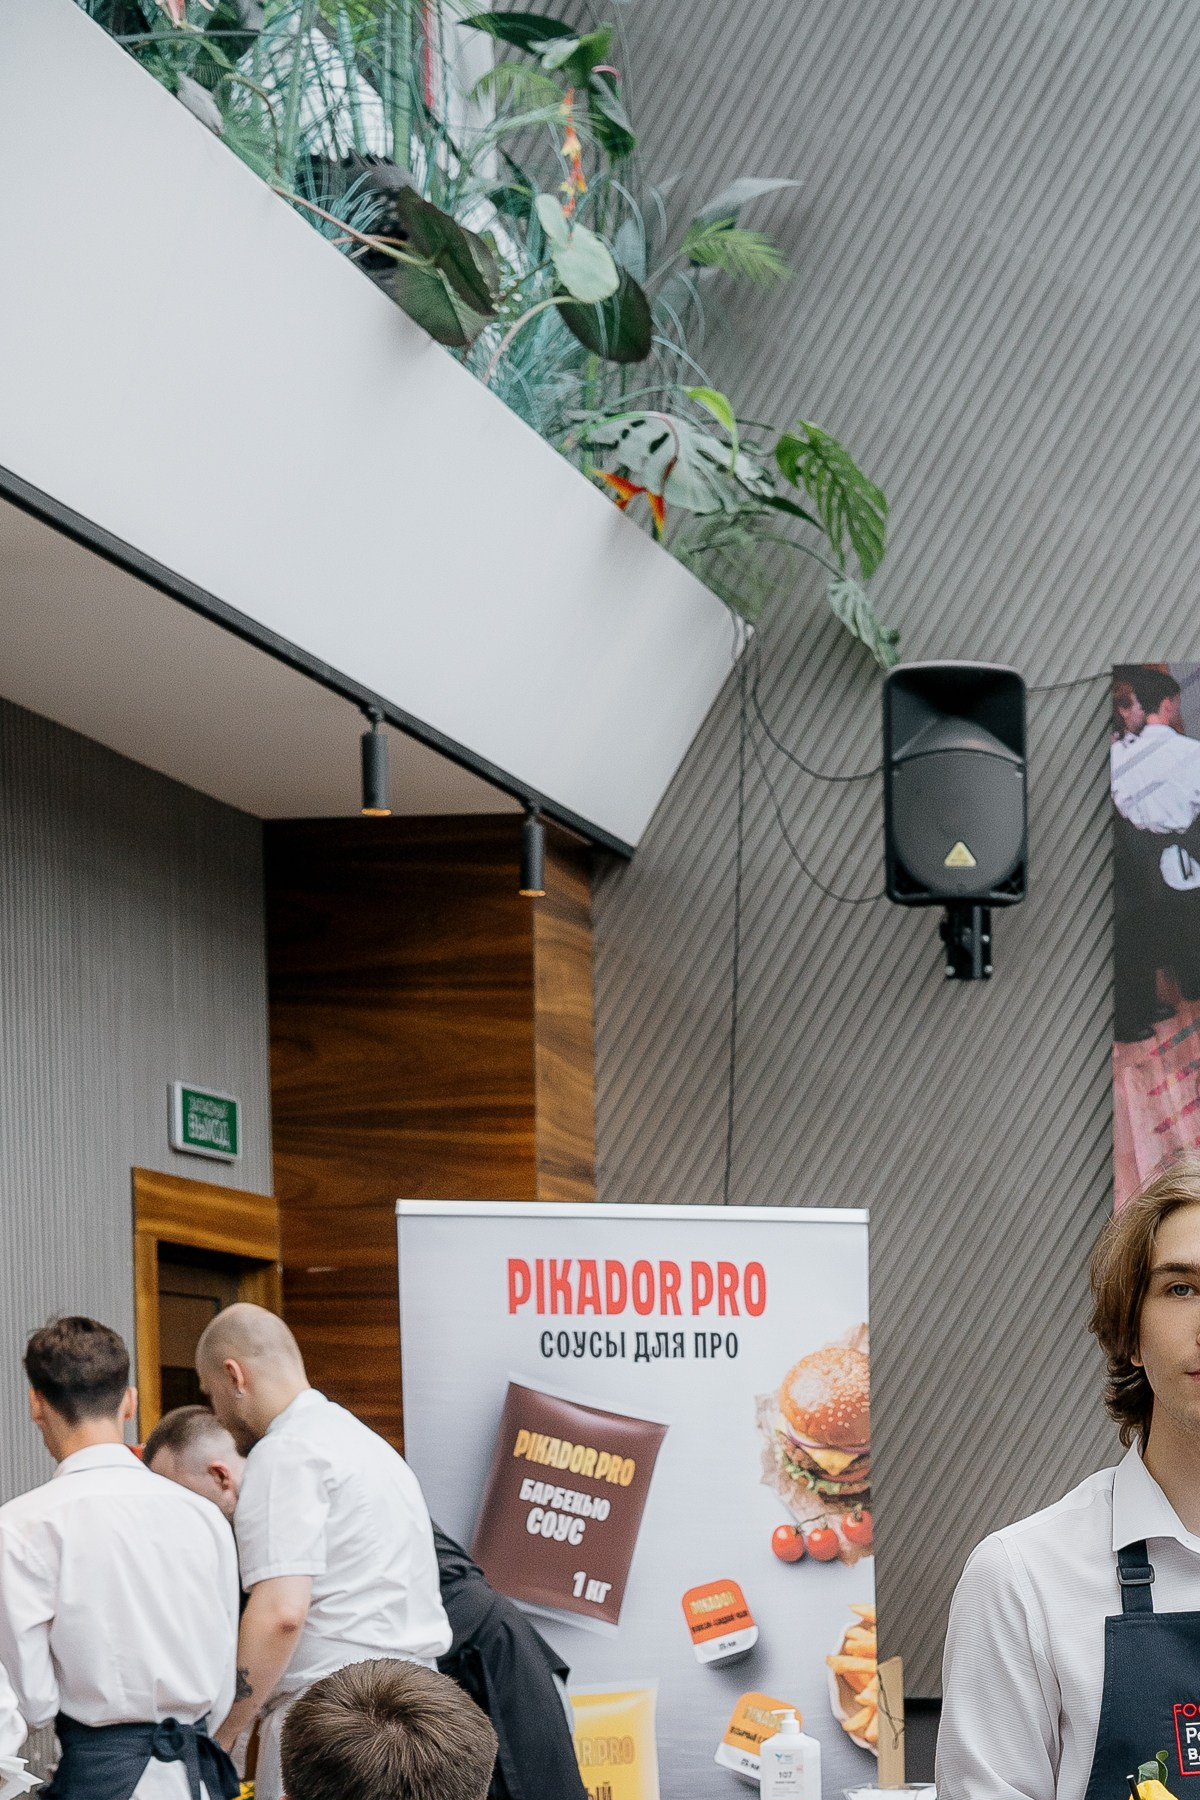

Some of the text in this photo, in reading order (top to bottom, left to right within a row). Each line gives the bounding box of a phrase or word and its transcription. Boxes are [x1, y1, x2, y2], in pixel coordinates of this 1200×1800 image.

[508, 1258, 767, 1317] PIKADOR PRO
[540, 1330, 739, 1362] СОУСЫ ДЛЯ ПРО
[513, 1429, 636, 1487] PIKADOR PRO
[519, 1478, 611, 1521] БАРБЕКЬЮ
[526, 1507, 586, 1545] СОУС
[572, 1571, 586, 1598] 1
